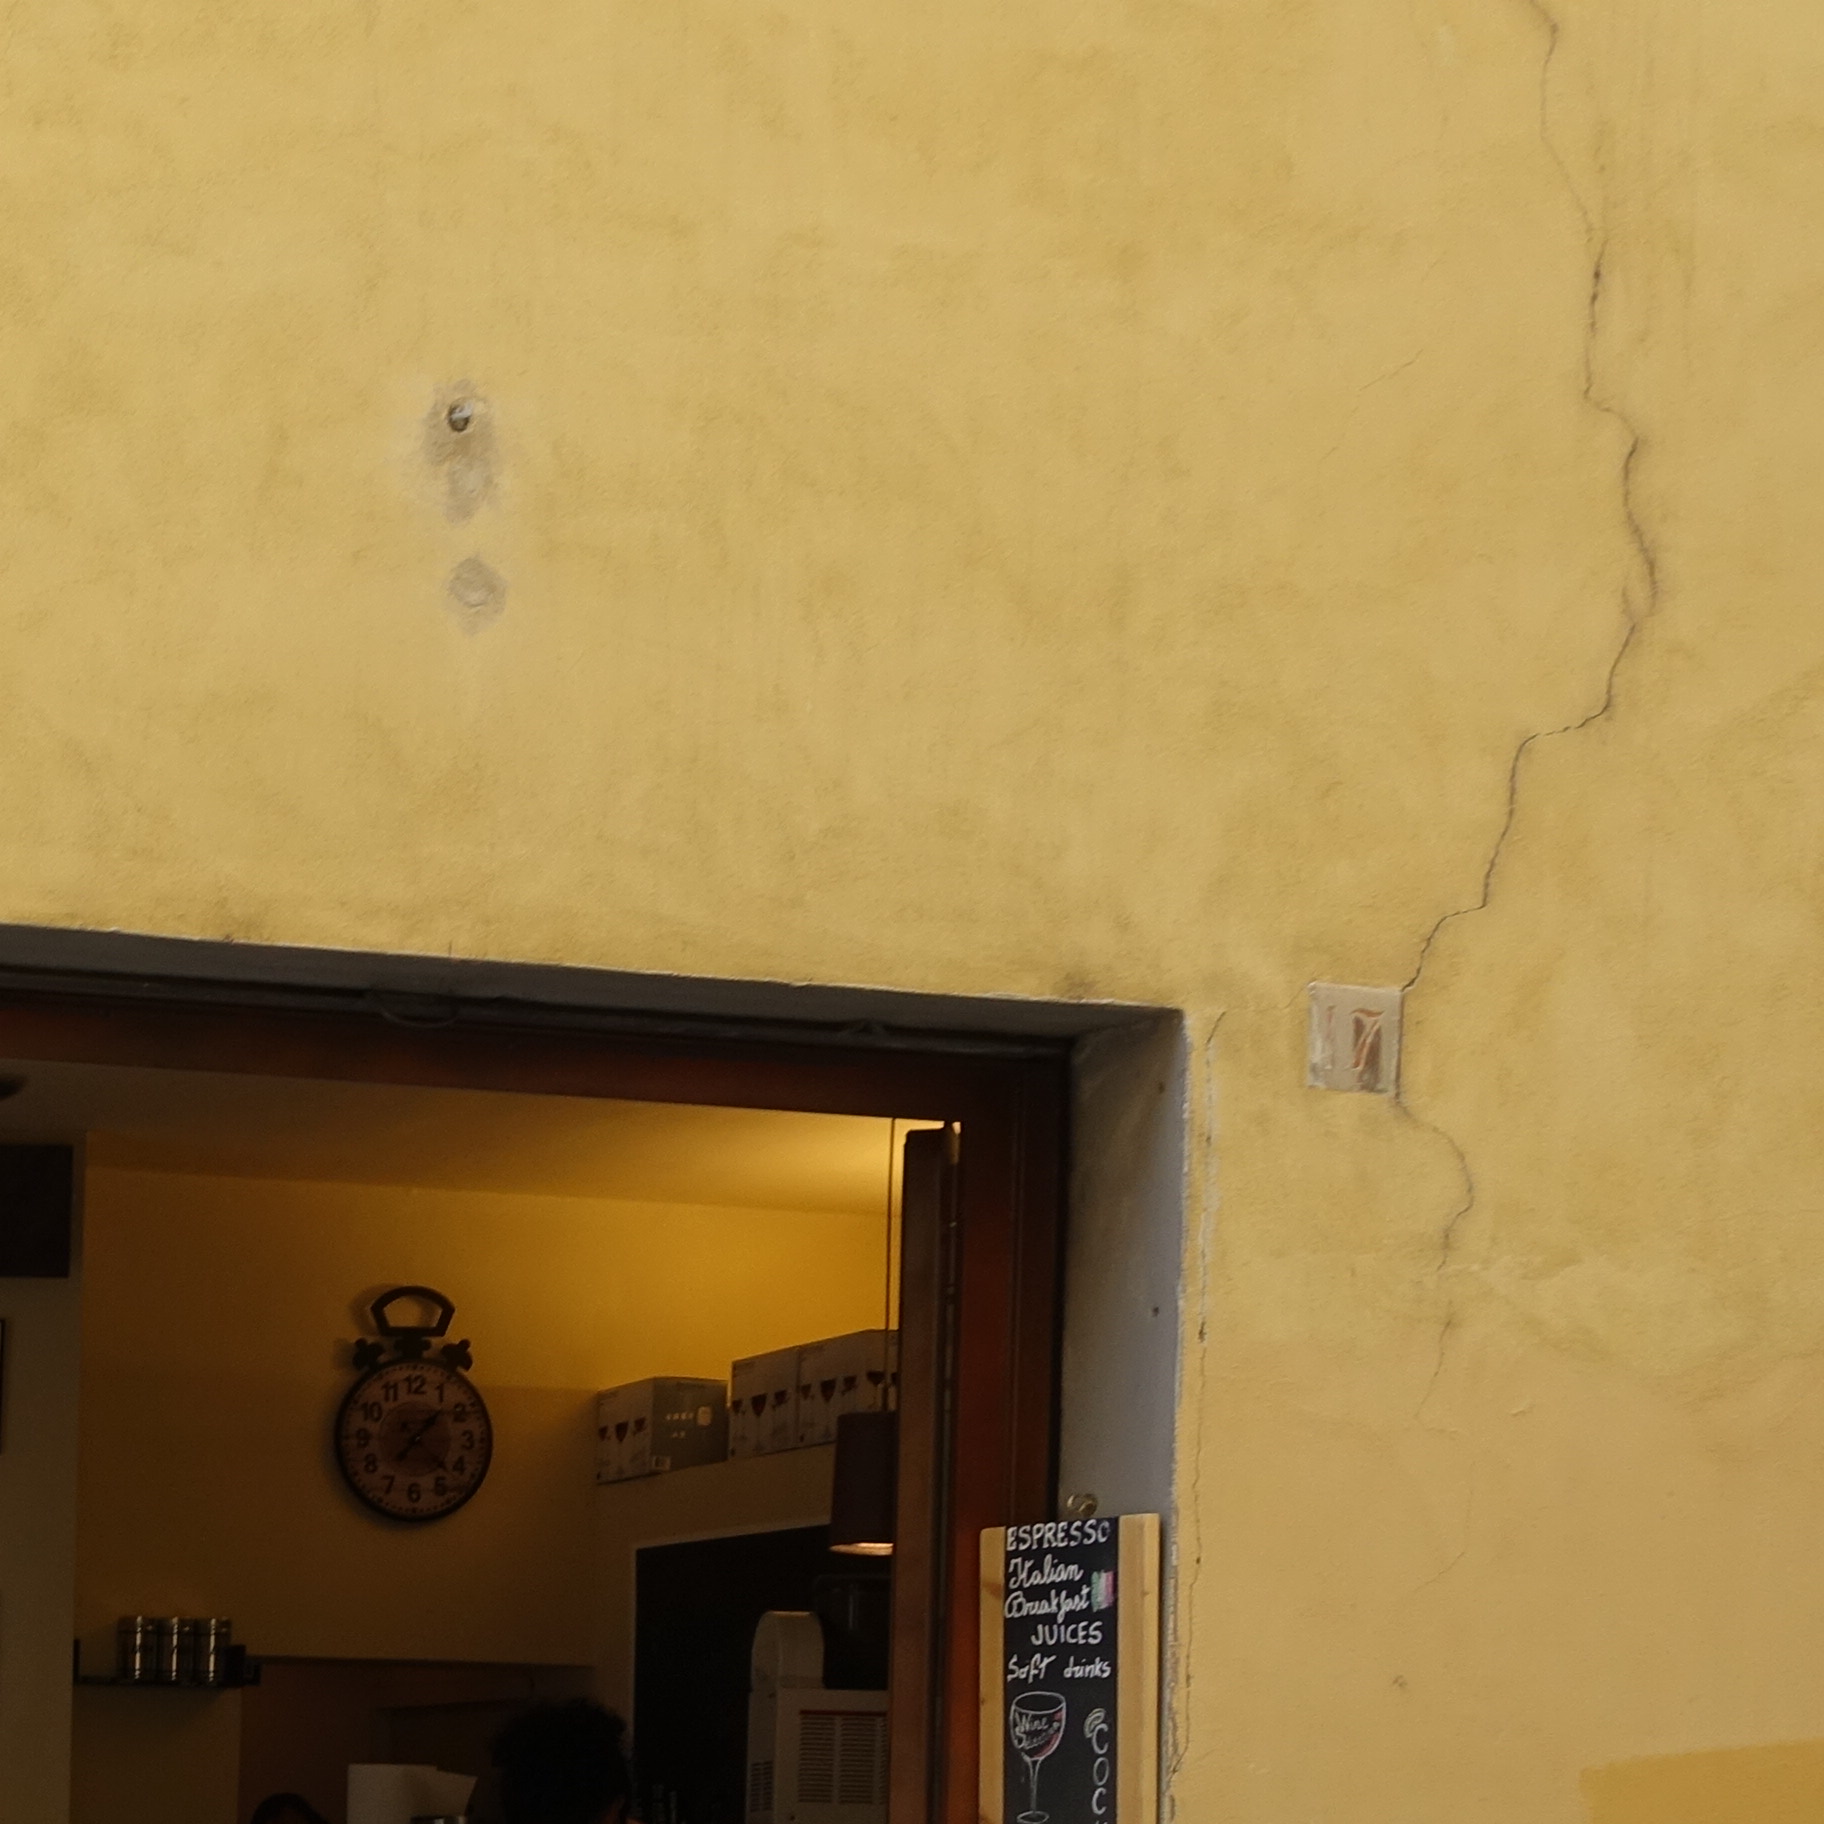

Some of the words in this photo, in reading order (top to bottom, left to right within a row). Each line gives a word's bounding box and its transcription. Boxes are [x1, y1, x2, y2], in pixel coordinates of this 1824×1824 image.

[1006, 1518, 1111, 1551] ESPRESSO
[1008, 1554, 1084, 1589] Italian
[1005, 1584, 1091, 1623] Breakfast
[1031, 1621, 1103, 1646] JUICES
[1007, 1653, 1056, 1683] Soft
[1063, 1656, 1111, 1679] drinks
[1015, 1711, 1050, 1733] Wine
